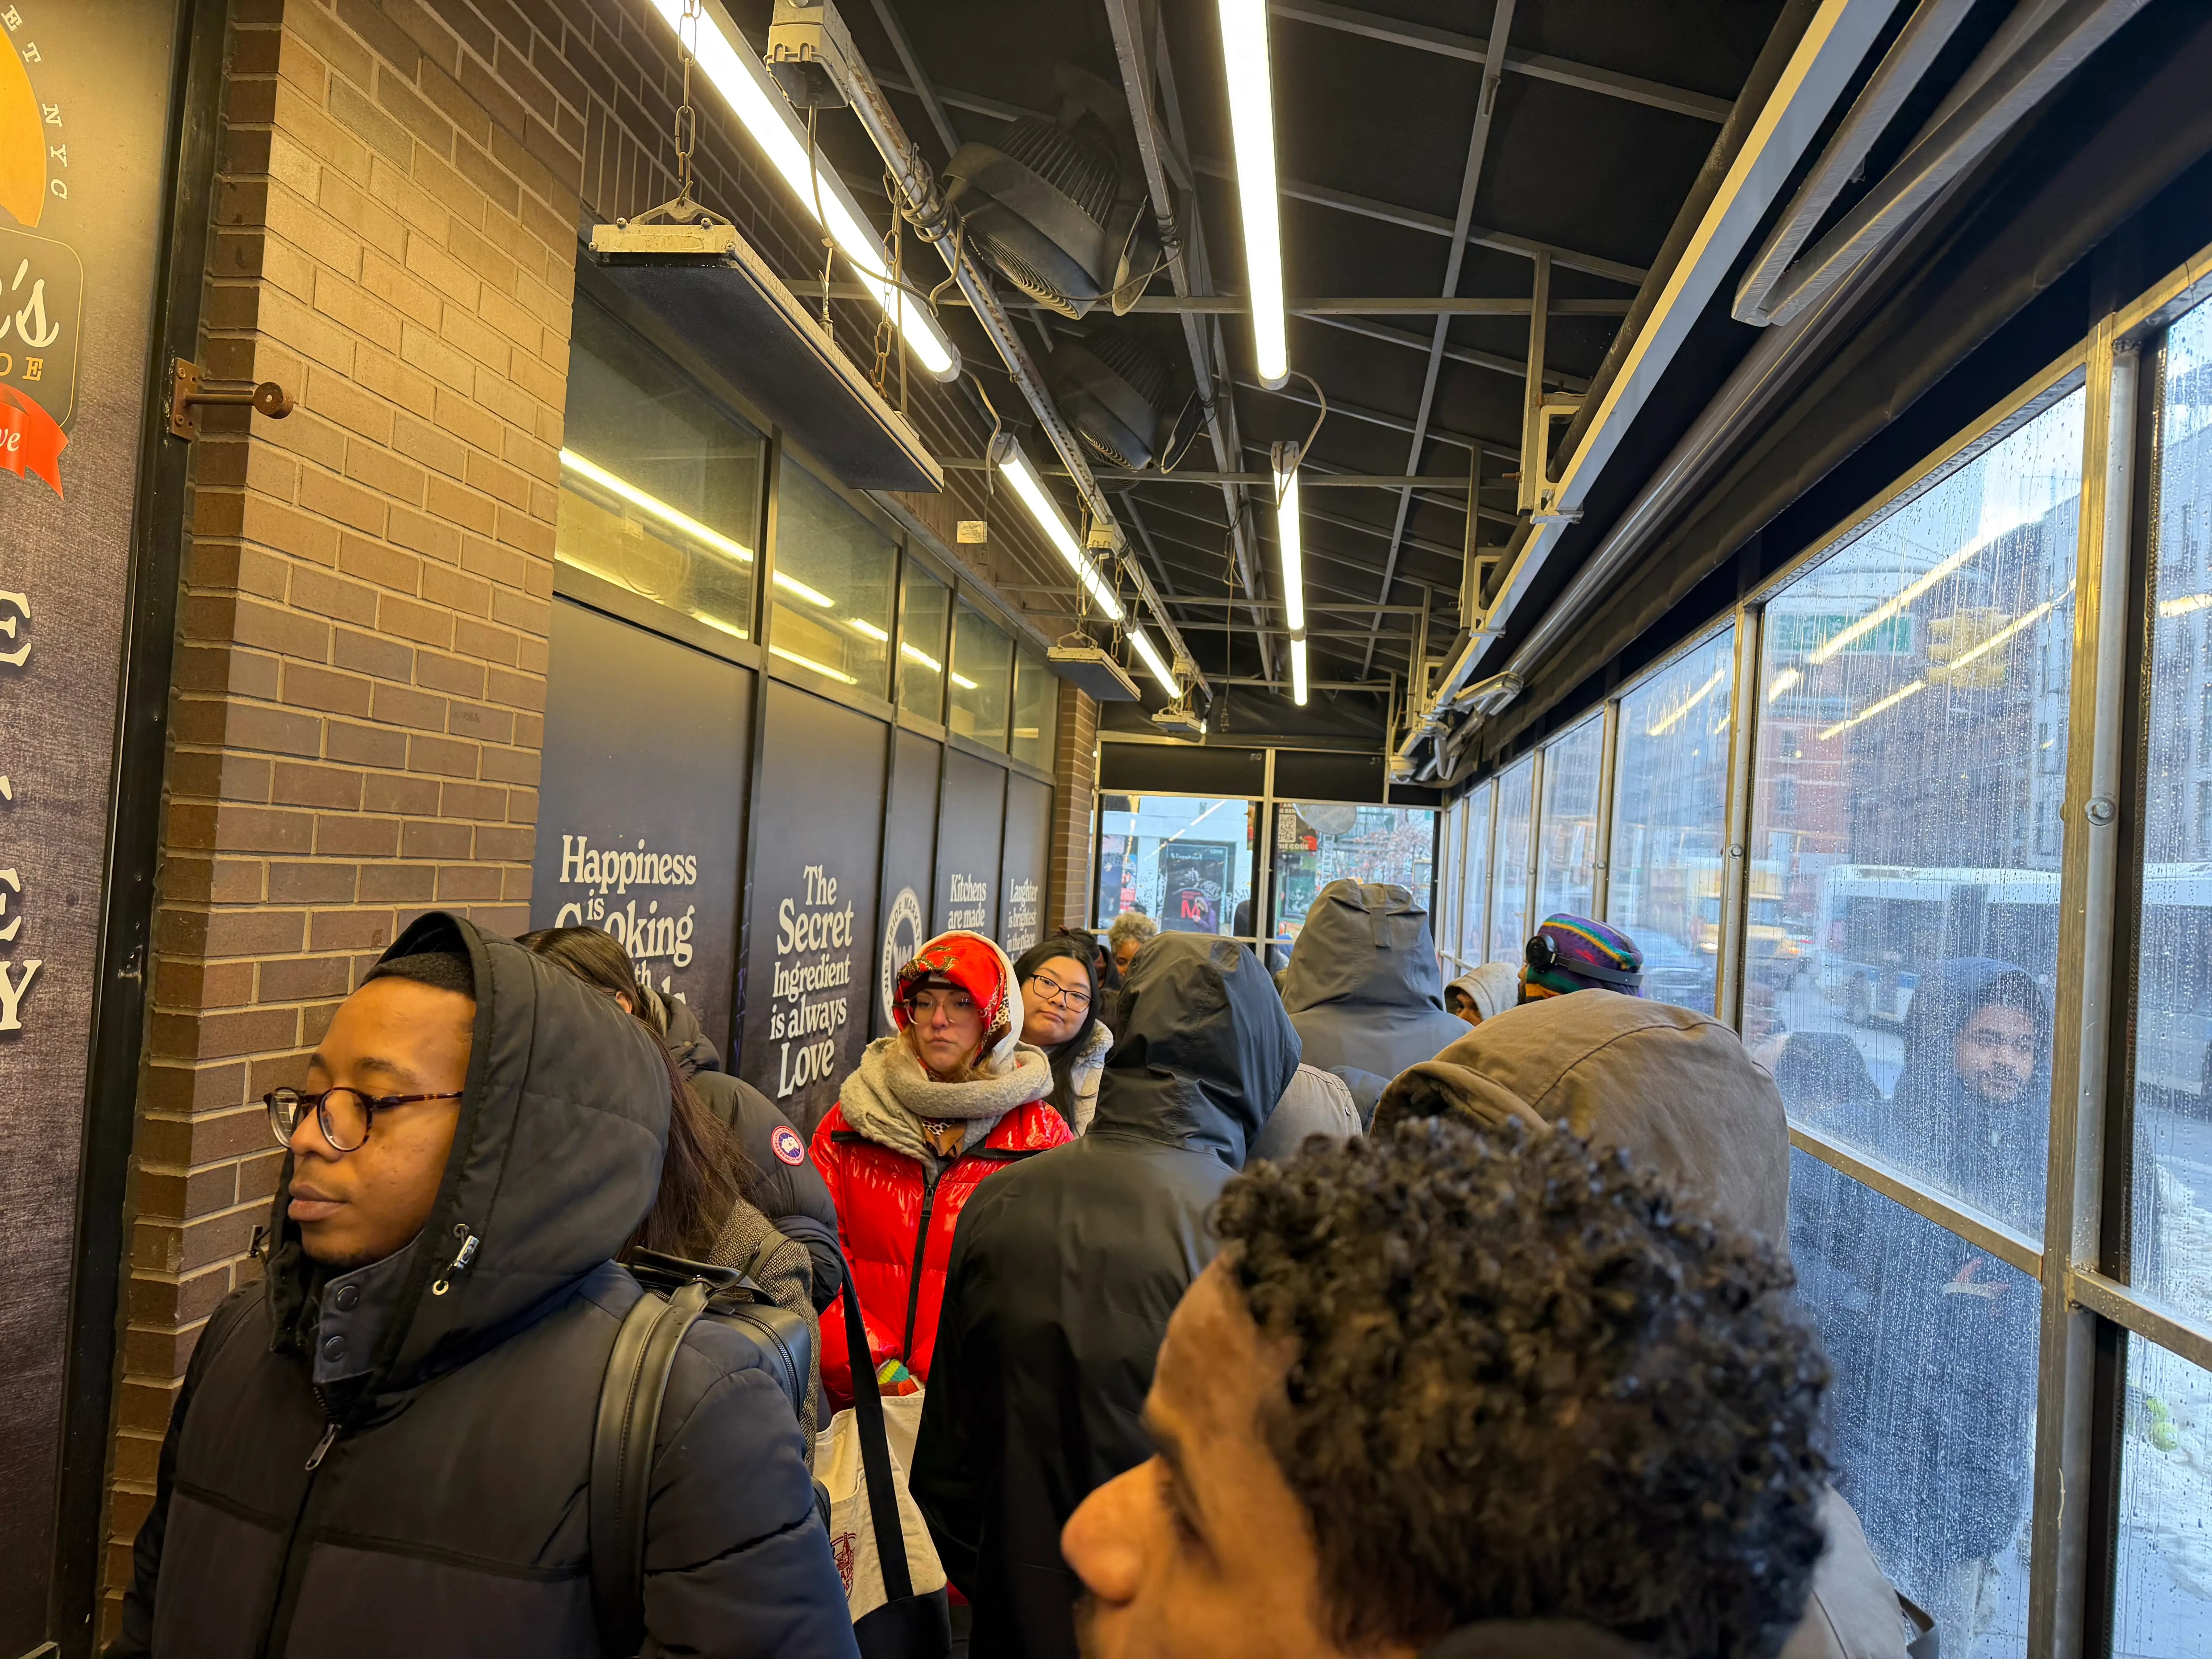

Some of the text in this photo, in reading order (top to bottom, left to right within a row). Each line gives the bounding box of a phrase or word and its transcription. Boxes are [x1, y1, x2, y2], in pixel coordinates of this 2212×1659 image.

[42, 103, 67, 199] NYC
[0, 258, 59, 347] 's
[559, 835, 697, 894] Happiness
[803, 864, 837, 906] The
[950, 874, 987, 902] Kitchens
[587, 888, 604, 920] is
[948, 902, 986, 930] are made
[1010, 878, 1039, 908] Laughter
[776, 898, 854, 955] Secret
[1007, 928, 1036, 955] in the place
[1008, 906, 1037, 931] is brightest
[885, 897, 921, 995] WESTSIDE MARKET
[772, 953, 851, 1003] Ingredient
[769, 993, 847, 1040] is always
[777, 1039, 835, 1099] Love
